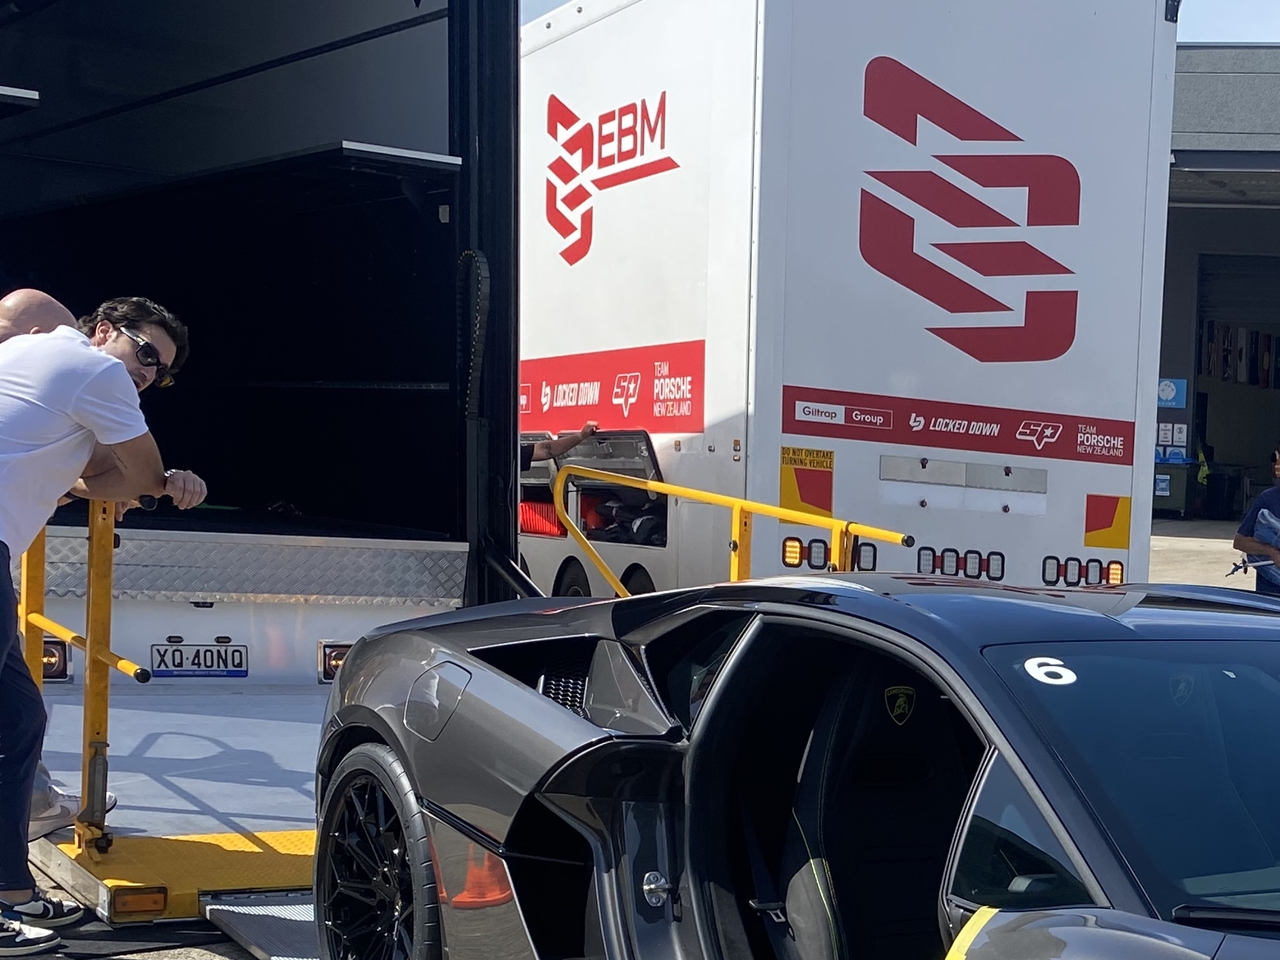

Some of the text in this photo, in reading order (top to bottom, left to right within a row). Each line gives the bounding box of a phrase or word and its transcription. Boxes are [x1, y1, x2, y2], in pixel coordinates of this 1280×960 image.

[598, 90, 666, 170] EBM
[654, 361, 670, 376] TEAM
[553, 383, 578, 407] LOCKED
[578, 381, 601, 405] DOWN
[653, 376, 692, 401] PORSCHE
[653, 400, 692, 417] NEW ZEALAND
[802, 406, 884, 426] Giltrap Group
[929, 417, 1001, 437] LOCKED DOWN
[1077, 424, 1096, 434] TEAM
[1077, 433, 1124, 449] PORSCHE
[782, 447, 833, 460] DO NOT OVERTAKE
[1077, 445, 1124, 457] NEW ZEALAND
[782, 457, 833, 469] TURNING VEHICLE
[1024, 656, 1078, 685] 6
